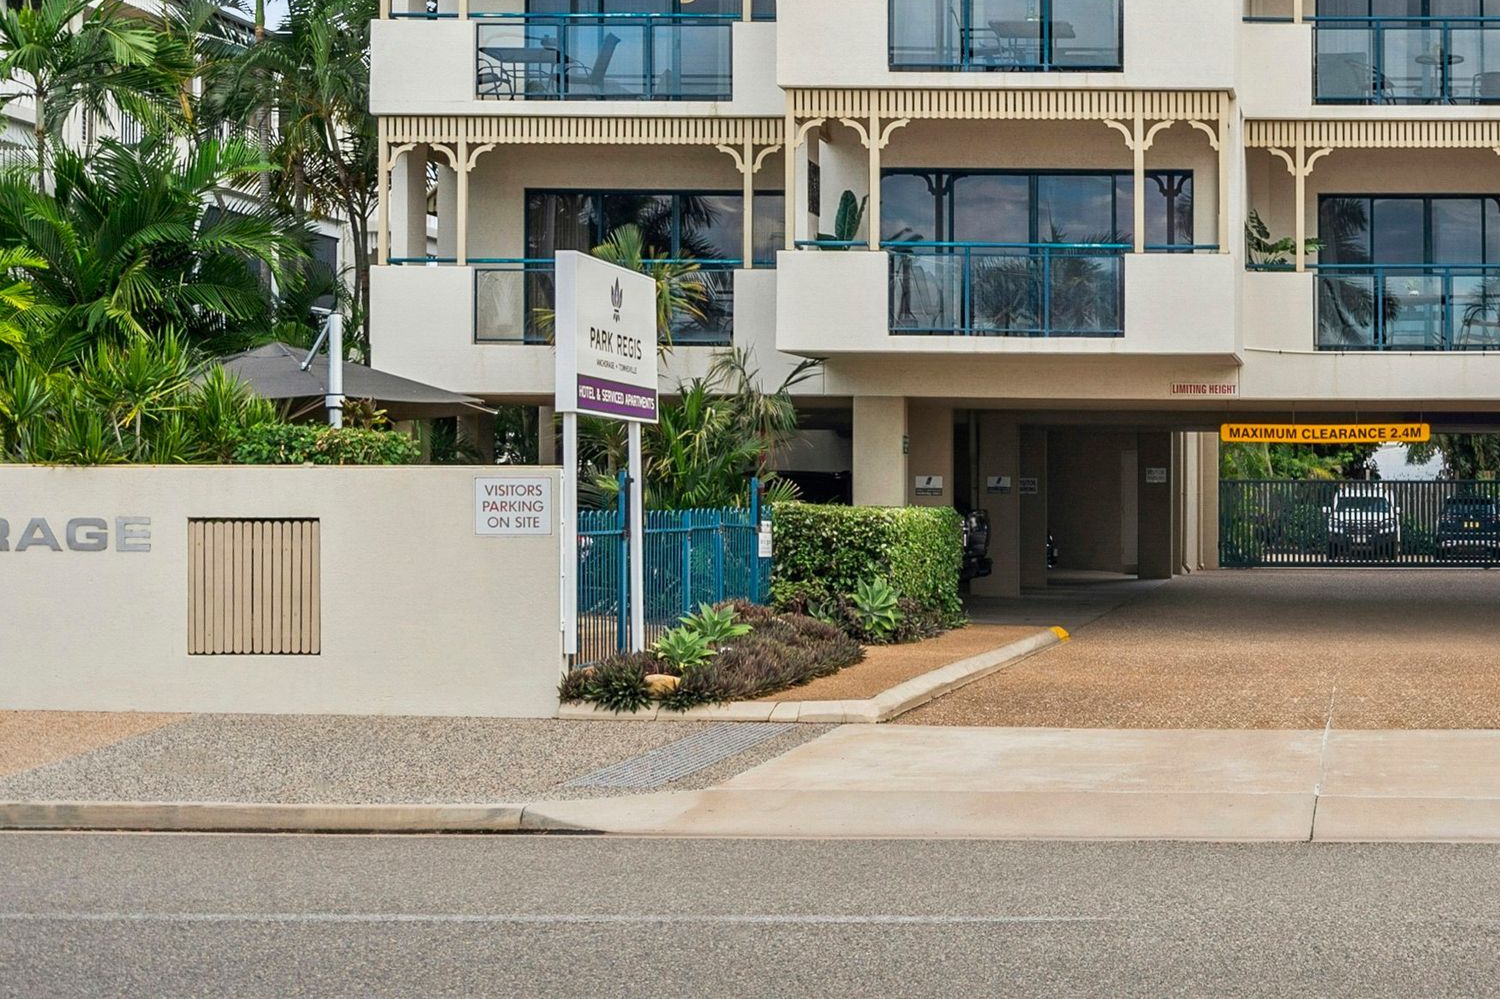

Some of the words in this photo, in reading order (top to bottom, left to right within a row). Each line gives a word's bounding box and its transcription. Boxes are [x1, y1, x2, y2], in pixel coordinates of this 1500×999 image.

[590, 326, 613, 354] PARK
[617, 334, 642, 360] REGIS
[1172, 384, 1207, 394] LIMITING
[1209, 384, 1236, 394] HEIGHT
[579, 385, 596, 400] HOTEL
[602, 389, 624, 405] SERVICED
[625, 394, 655, 410] APARTMENTS
[1229, 427, 1297, 439] MAXIMUM
[1301, 427, 1386, 440] CLEARANCE
[1390, 427, 1421, 439] 2.4M
[484, 484, 543, 497] VISITORS
[482, 500, 544, 513] PARKING
[487, 516, 510, 529] ON
[515, 516, 540, 529] SITE
[0, 516, 152, 552] AGE
